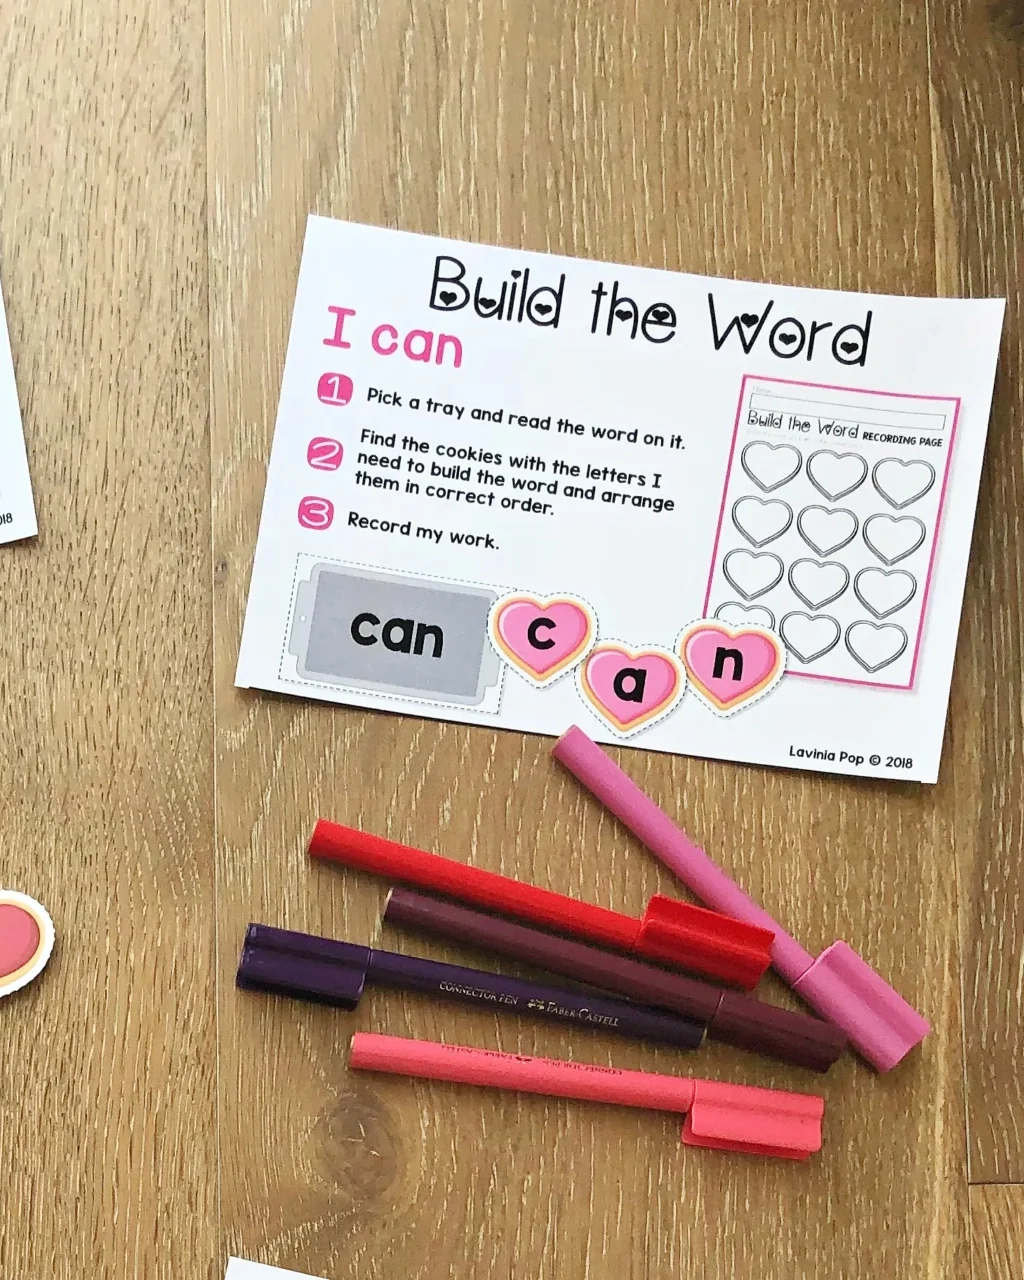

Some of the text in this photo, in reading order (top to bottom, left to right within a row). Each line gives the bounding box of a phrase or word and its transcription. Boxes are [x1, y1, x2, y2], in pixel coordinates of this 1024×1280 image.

[322, 305, 463, 369] I can
[429, 255, 873, 367] Build the Word
[320, 375, 686, 450] 1 Pick a tray and read the word on it.
[747, 410, 783, 429] Build
[788, 416, 811, 433] the
[818, 418, 860, 438] Word
[862, 431, 917, 446] RECORDING
[919, 437, 943, 447] PAGE
[310, 429, 662, 489] 2 Find the cookies with the letters I
[357, 451, 675, 513] need to build the word and arrange
[355, 470, 555, 516] them in correct order.
[302, 499, 500, 550] 3 Record my work.
[350, 610, 443, 659] can
[527, 614, 744, 704] c a n
[789, 743, 836, 765] Lavinia
[839, 749, 865, 768] Pop
[885, 755, 914, 770] 2018
[439, 981, 497, 1001] CONNECTOR
[498, 993, 520, 1005] PEN
